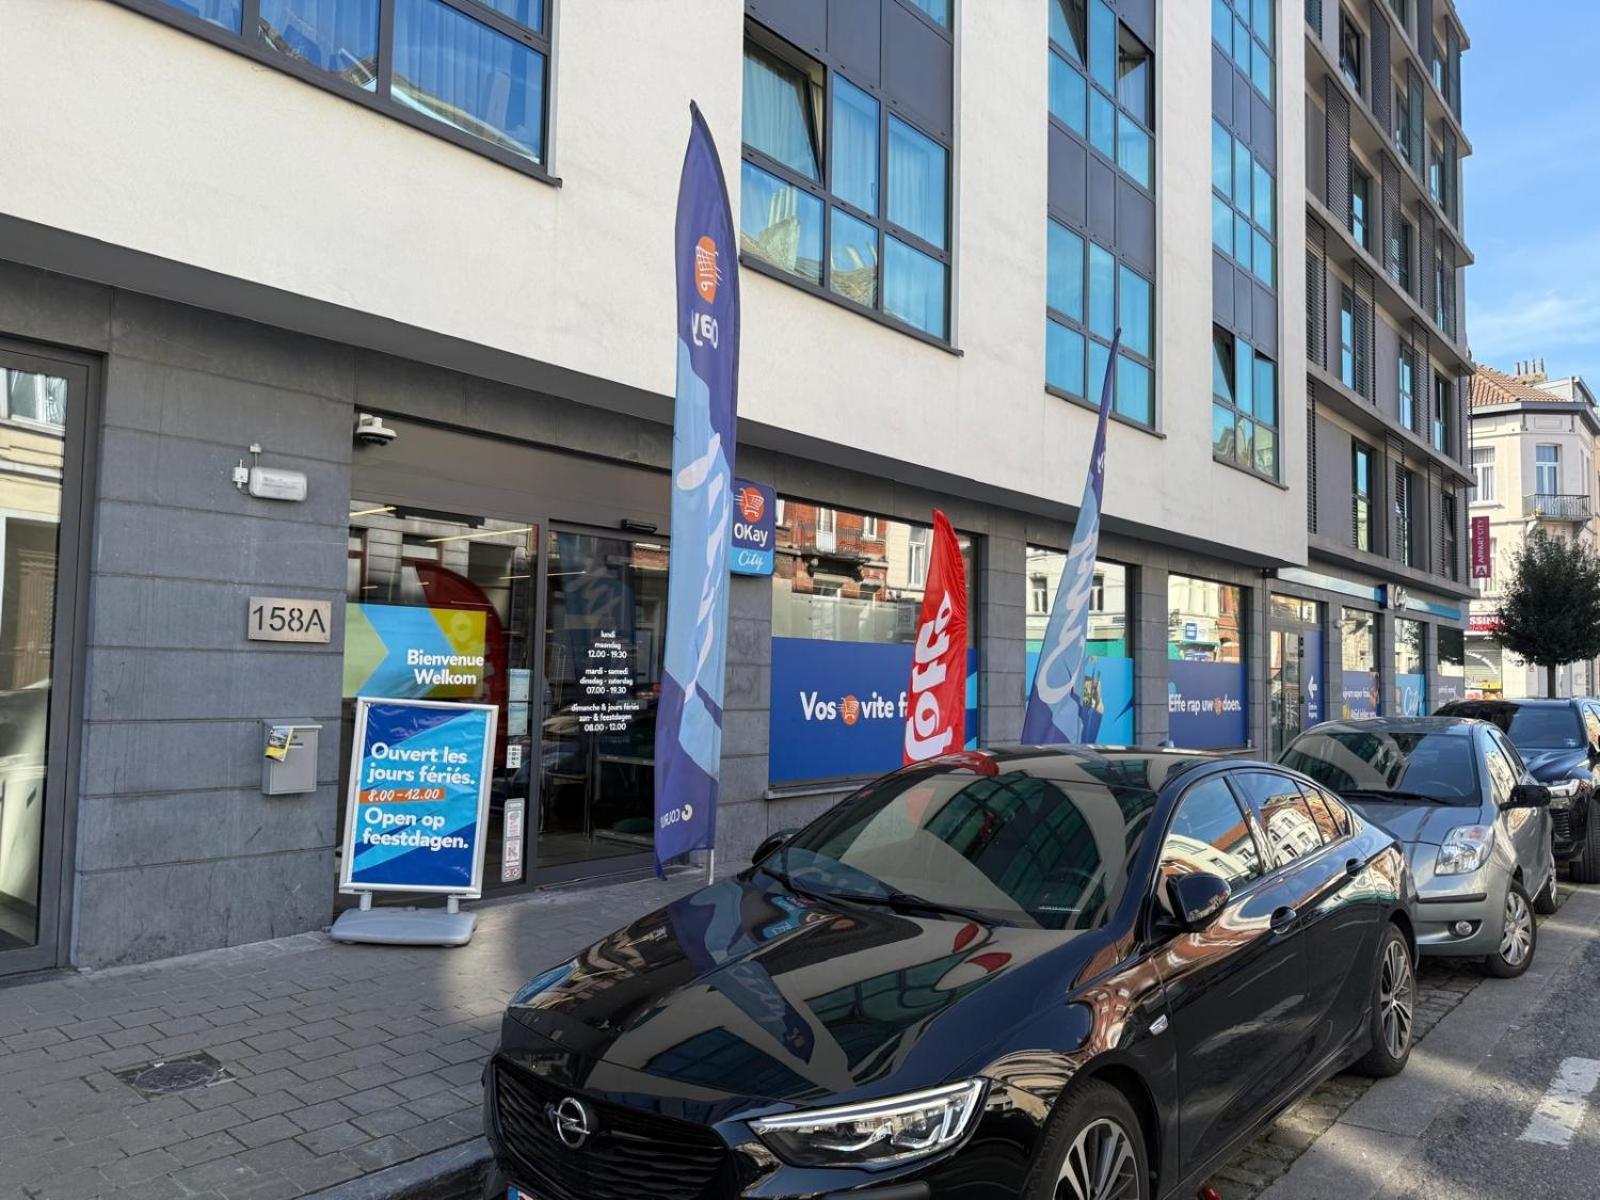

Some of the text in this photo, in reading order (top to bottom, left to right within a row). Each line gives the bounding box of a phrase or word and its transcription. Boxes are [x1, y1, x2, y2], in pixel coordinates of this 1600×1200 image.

[734, 523, 768, 547] OKay
[738, 550, 764, 571] City
[253, 606, 326, 633] 158A
[601, 630, 616, 638] lundi
[407, 649, 484, 666] Bienvenue
[588, 650, 606, 658] 12.00
[611, 651, 627, 659] 19.30
[414, 669, 477, 685] Welkom
[585, 667, 603, 675] mardi
[608, 667, 629, 675] samedi
[580, 677, 603, 686] dinsdag
[608, 677, 633, 686] zaterdag
[586, 686, 605, 694] 07.00
[610, 686, 627, 694] 19.30
[571, 703, 600, 712] dimanche
[608, 703, 622, 712] jours
[800, 691, 837, 721] Vos
[861, 691, 895, 719] vite
[1168, 693, 1242, 716] Effe rap uw doen.
[600, 713, 632, 722] feestdagen
[584, 724, 604, 732] 08.00
[609, 723, 627, 731] 12.00
[371, 742, 468, 764] Ouvert les
[367, 763, 476, 785] jours fériés.
[365, 807, 445, 830] Open op
[363, 830, 469, 851] feestdagen.
